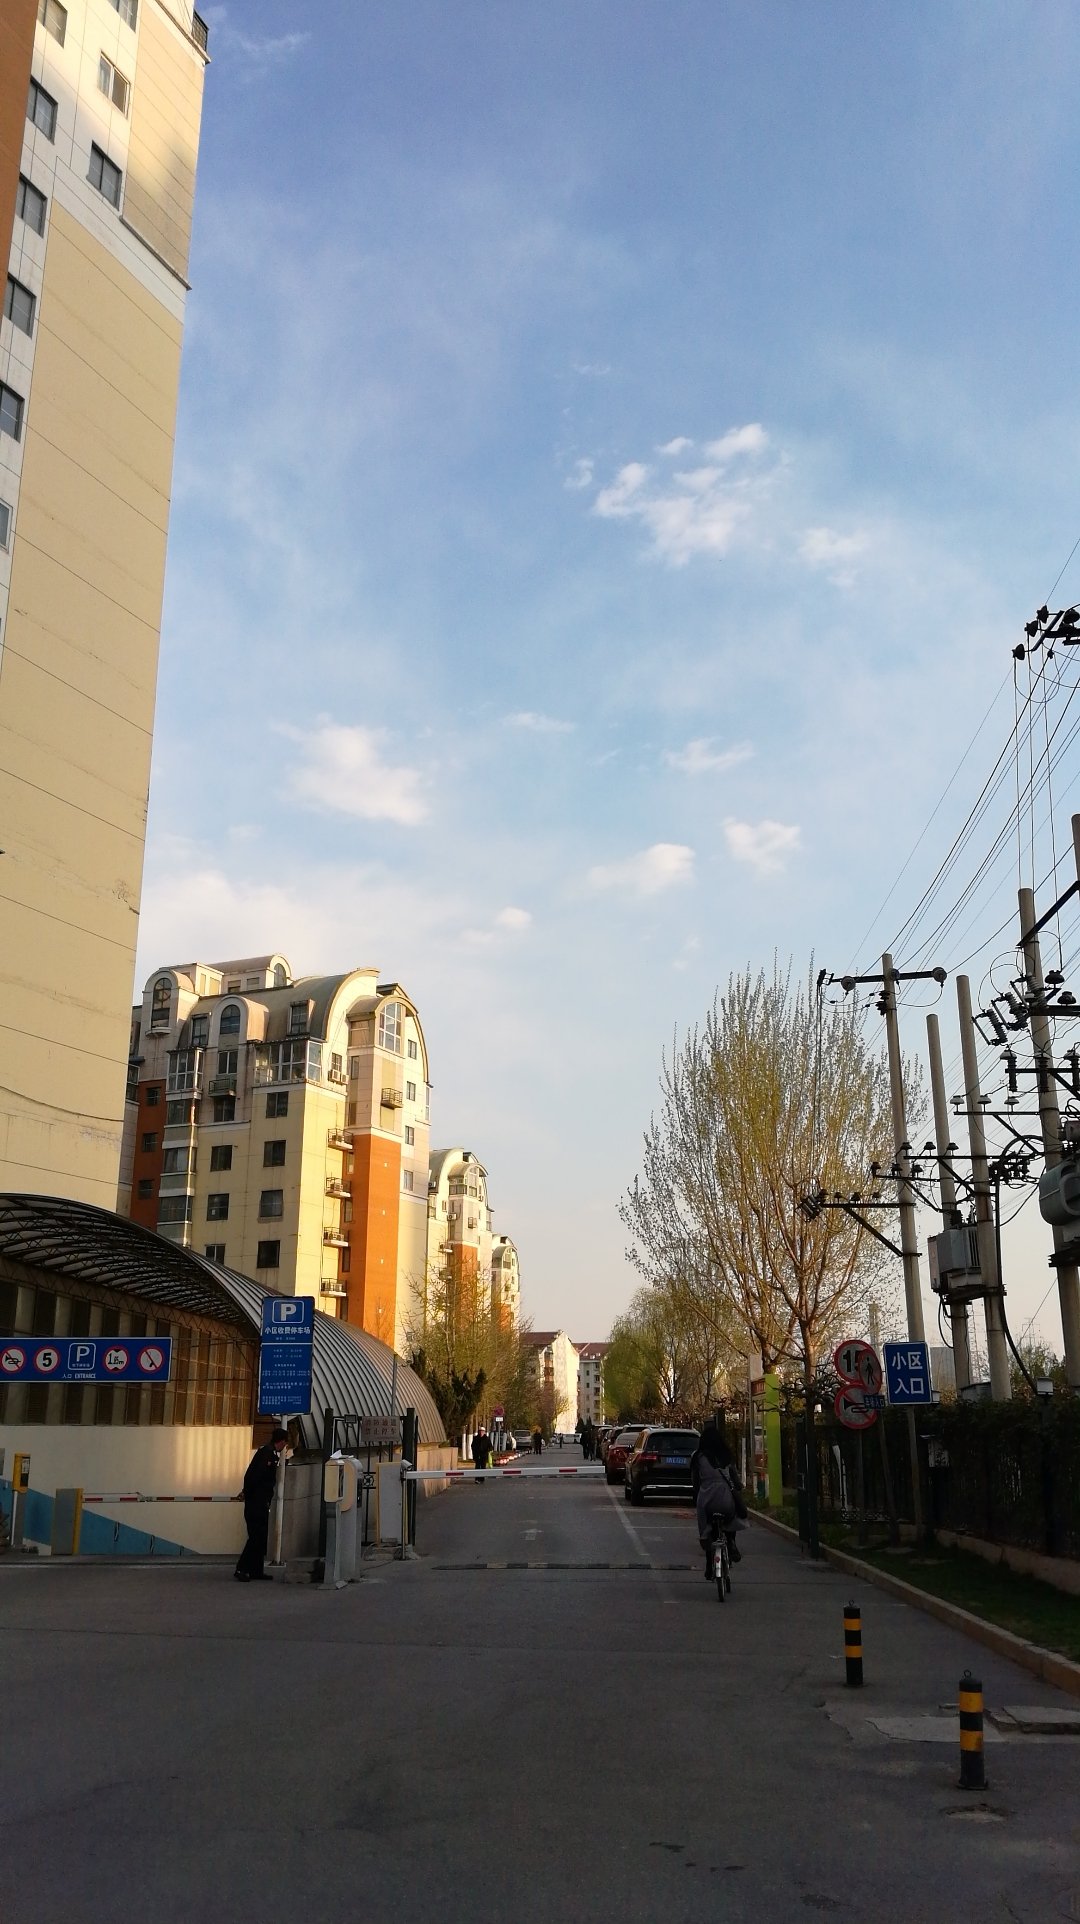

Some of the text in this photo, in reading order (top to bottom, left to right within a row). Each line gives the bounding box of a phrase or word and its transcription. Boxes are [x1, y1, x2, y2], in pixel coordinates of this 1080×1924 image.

[281, 1304, 296, 1321] P
[264, 1327, 311, 1335] 小区收费停车场
[42, 1352, 52, 1367] 5
[76, 1346, 90, 1361] P
[892, 1352, 923, 1370] 小区
[895, 1378, 925, 1395] 入口
